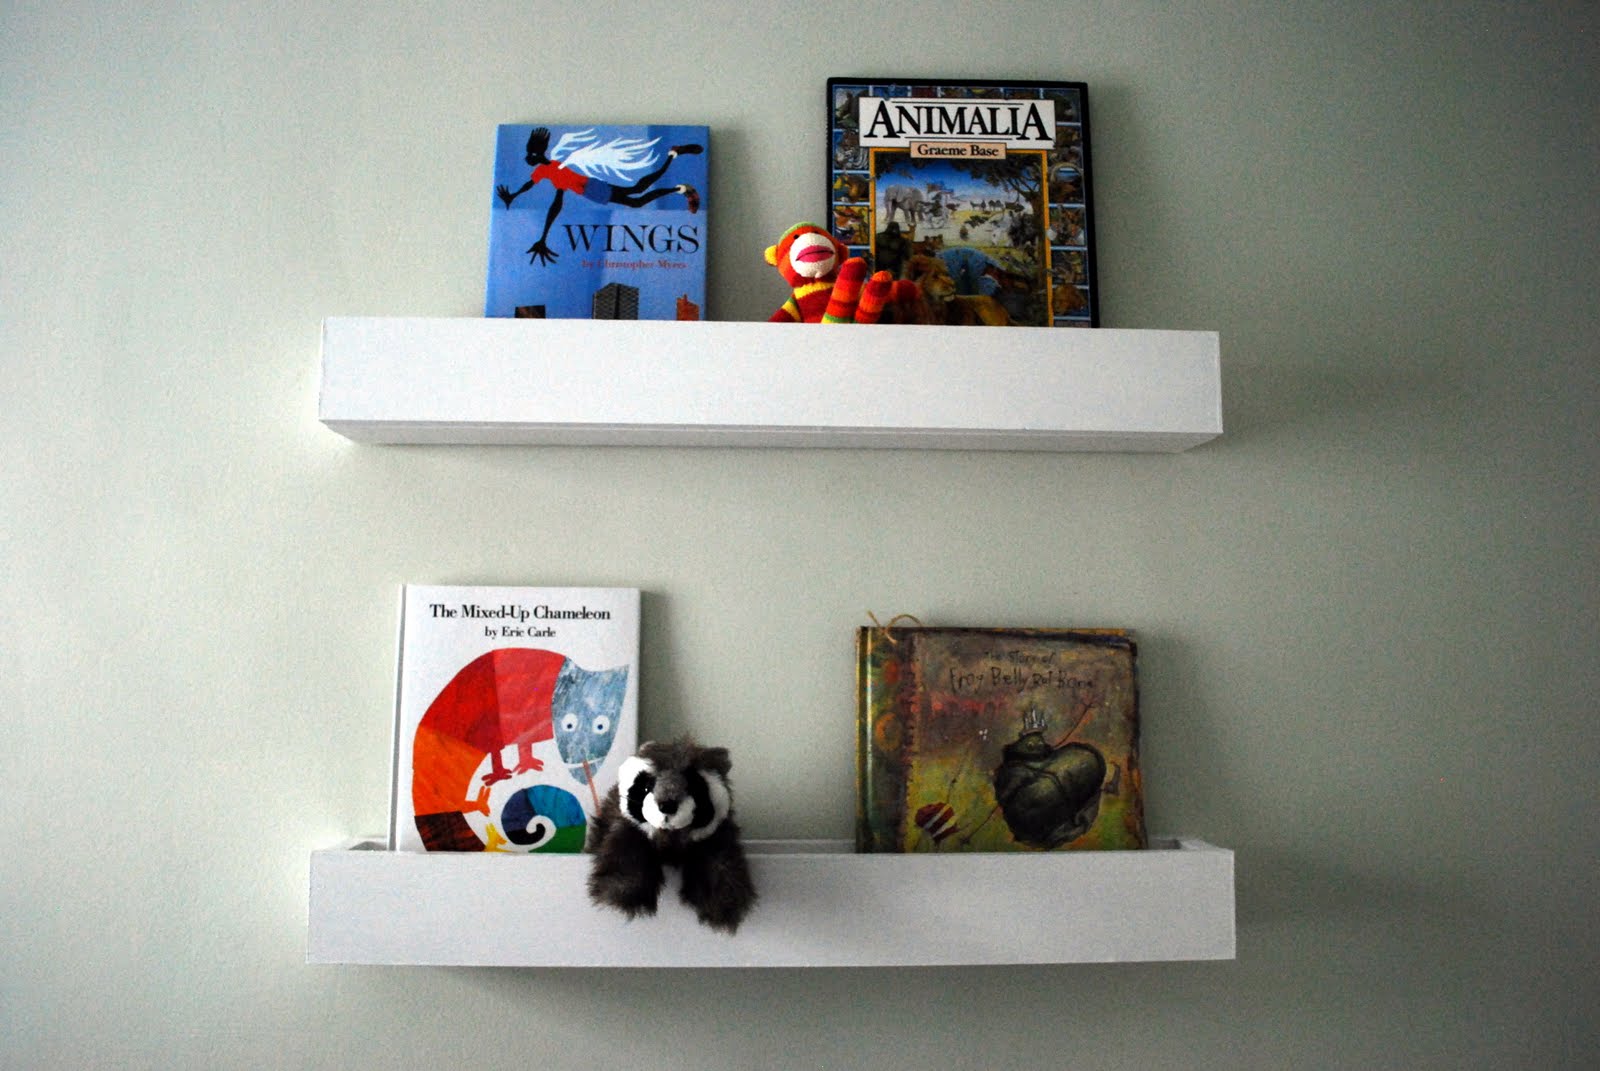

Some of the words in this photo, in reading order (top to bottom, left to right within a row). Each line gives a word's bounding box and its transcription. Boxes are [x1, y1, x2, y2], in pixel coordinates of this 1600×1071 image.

[864, 100, 1053, 141] ANIMALIA
[917, 143, 967, 156] Graeme
[970, 145, 999, 157] Base
[562, 224, 700, 254] WINGS
[429, 604, 457, 618] The
[461, 604, 530, 623] Mixed-Up
[533, 605, 611, 620] Chameleon
[484, 626, 498, 639] by
[501, 626, 525, 638] Eric
[527, 627, 557, 638] Carle
[991, 666, 1030, 693] Belly
